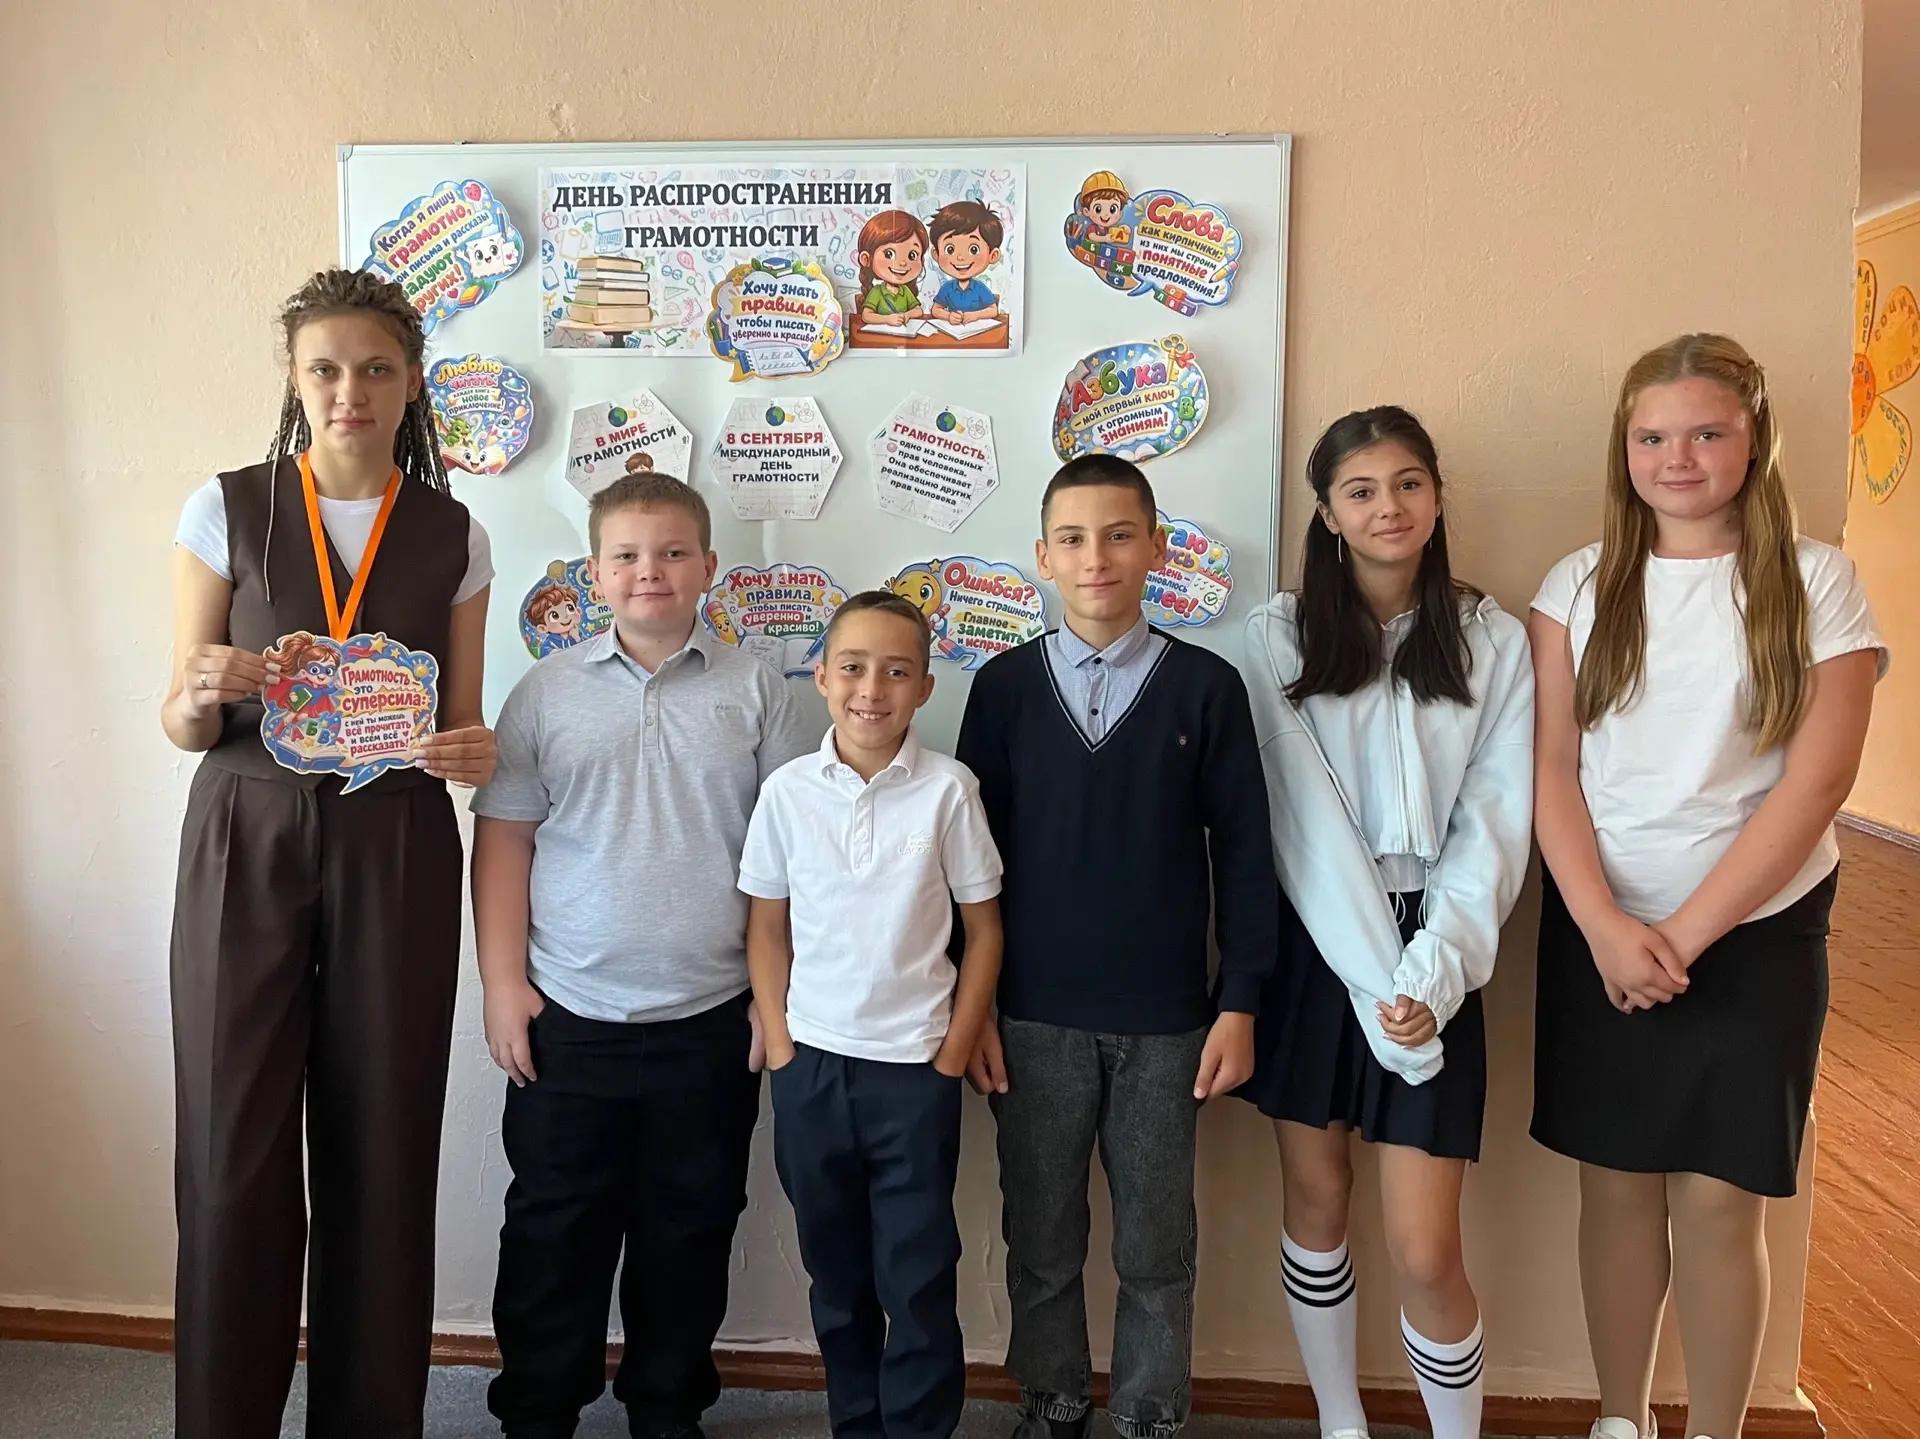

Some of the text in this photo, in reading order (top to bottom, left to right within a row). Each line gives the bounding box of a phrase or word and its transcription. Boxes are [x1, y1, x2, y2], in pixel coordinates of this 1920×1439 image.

[552, 183, 892, 212] ДЕНЬ РАСПРОСТРАНЕНИЯ
[378, 191, 456, 252] Когда я пишу
[1147, 196, 1225, 243] Слова
[388, 204, 472, 269] грамотно,
[409, 244, 443, 272] письма
[451, 212, 490, 243] рассказы
[624, 225, 819, 248] ГРАМОТНОСТИ
[1141, 225, 1224, 260] как кирпичики:
[1140, 239, 1218, 271] из них мы строим
[414, 264, 466, 314] ругих!
[742, 281, 819, 300] Хочу знать
[1137, 263, 1220, 299] предложения!
[741, 296, 818, 320] правила,
[736, 315, 816, 332] чтобы писать
[732, 330, 771, 341] уверенно
[780, 333, 818, 343] красиво!
[435, 353, 502, 384] Люблю
[1071, 361, 1166, 413] Азбука
[1082, 411, 1101, 425] мой
[1103, 395, 1142, 417] первый
[1144, 389, 1175, 403] ключ
[1097, 407, 1163, 433] к огромным
[1101, 411, 1169, 446] знаниям!
[575, 426, 677, 467] ГРАМОТНОСТИ
[595, 423, 648, 447] В МИРЕ
[727, 432, 823, 444] 8 СЕНТЯБРЯ
[893, 423, 986, 460] ГРАМОТНОСТЬ
[720, 447, 830, 459] МЕЖДУНАРОДНЫЙ
[898, 450, 967, 478] прав человека.
[900, 440, 922, 452] одно
[924, 447, 936, 456] из
[938, 452, 984, 472] основных
[732, 473, 819, 482] ГРАМОТНОСТИ
[760, 461, 792, 471] ДЕНЬ
[888, 456, 972, 489] Она обеспечивает
[881, 466, 972, 500] реализацию других
[890, 479, 912, 491] прав
[914, 487, 957, 506] человека
[728, 572, 826, 591] Хочу знать
[944, 561, 1036, 606] Ошибся?
[1147, 574, 1188, 593] ановлюсь
[746, 588, 815, 603] правила,
[748, 603, 812, 612] чтобы писать
[950, 590, 1041, 622] Ничего страшного!
[1141, 584, 1199, 619] нее!
[745, 611, 800, 625] уверенно
[768, 622, 820, 636] красиво!
[964, 612, 1008, 629] Главное
[957, 623, 1025, 645] заметить
[965, 638, 1012, 654] исправ
[342, 690, 427, 715] суперсила:
[354, 686, 373, 695] это
[351, 717, 364, 726] ней
[367, 716, 377, 725] ты
[378, 713, 405, 723] можешь
[365, 721, 412, 737] прочитать
[351, 739, 410, 757] рассказать!
